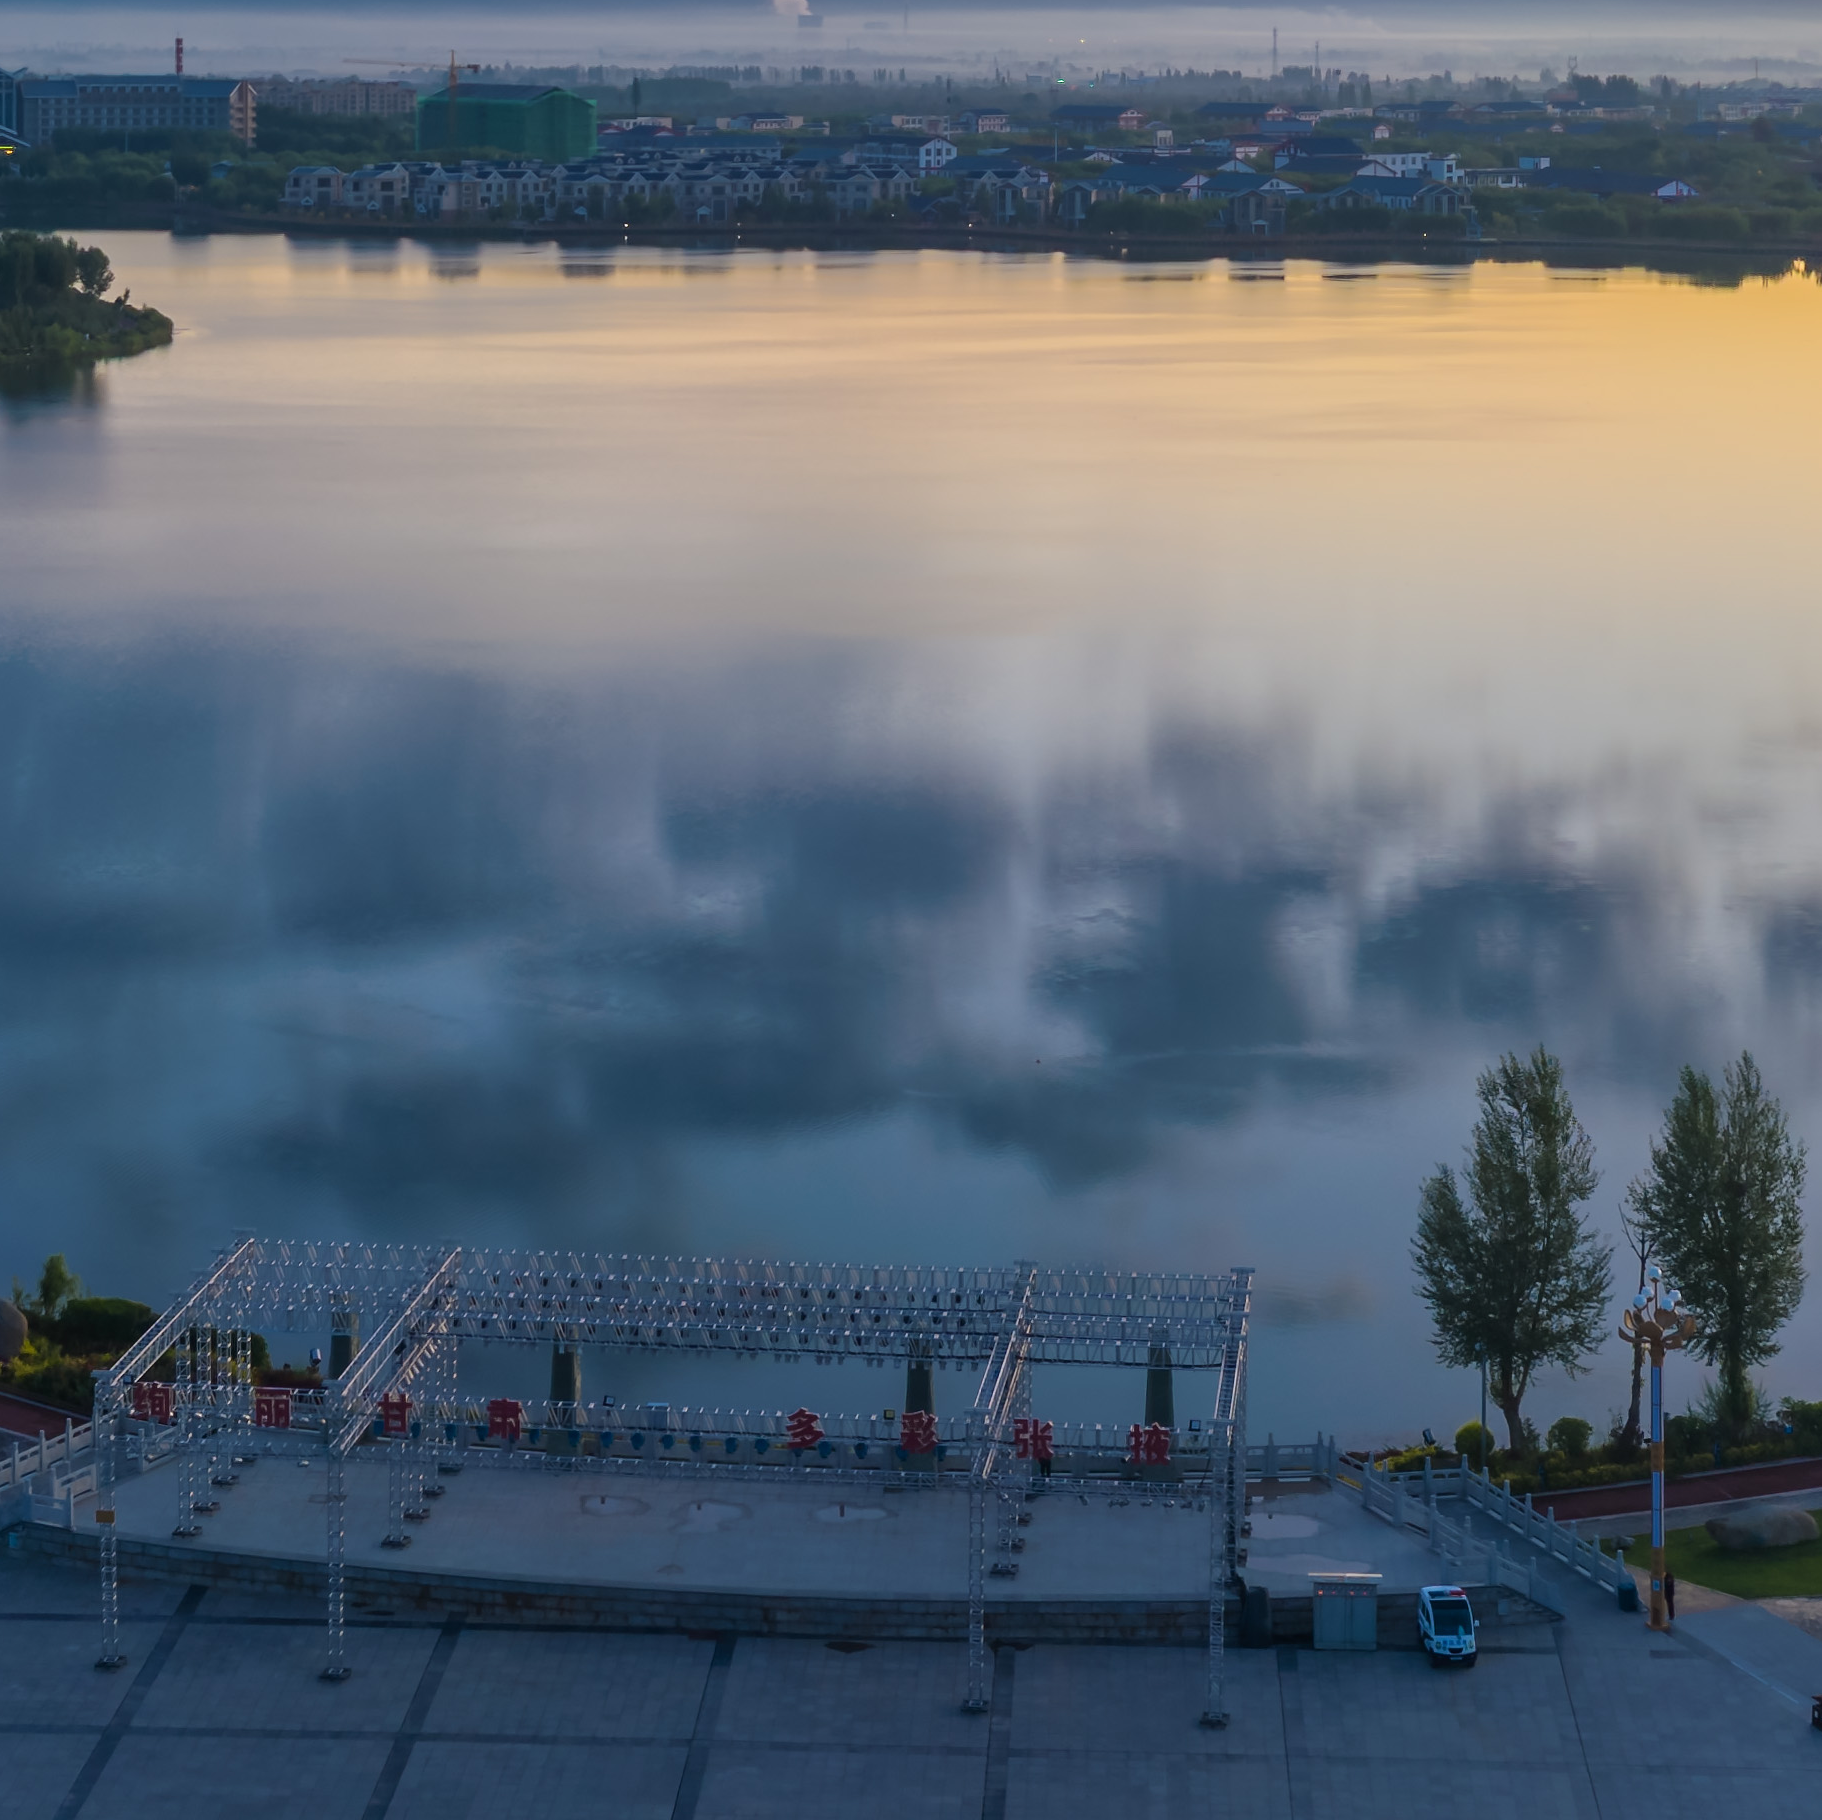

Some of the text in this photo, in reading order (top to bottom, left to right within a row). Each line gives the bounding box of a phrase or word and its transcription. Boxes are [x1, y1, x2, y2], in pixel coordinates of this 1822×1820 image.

[133, 1382, 1171, 1465] 绚丽甘肃 多彩张掖
